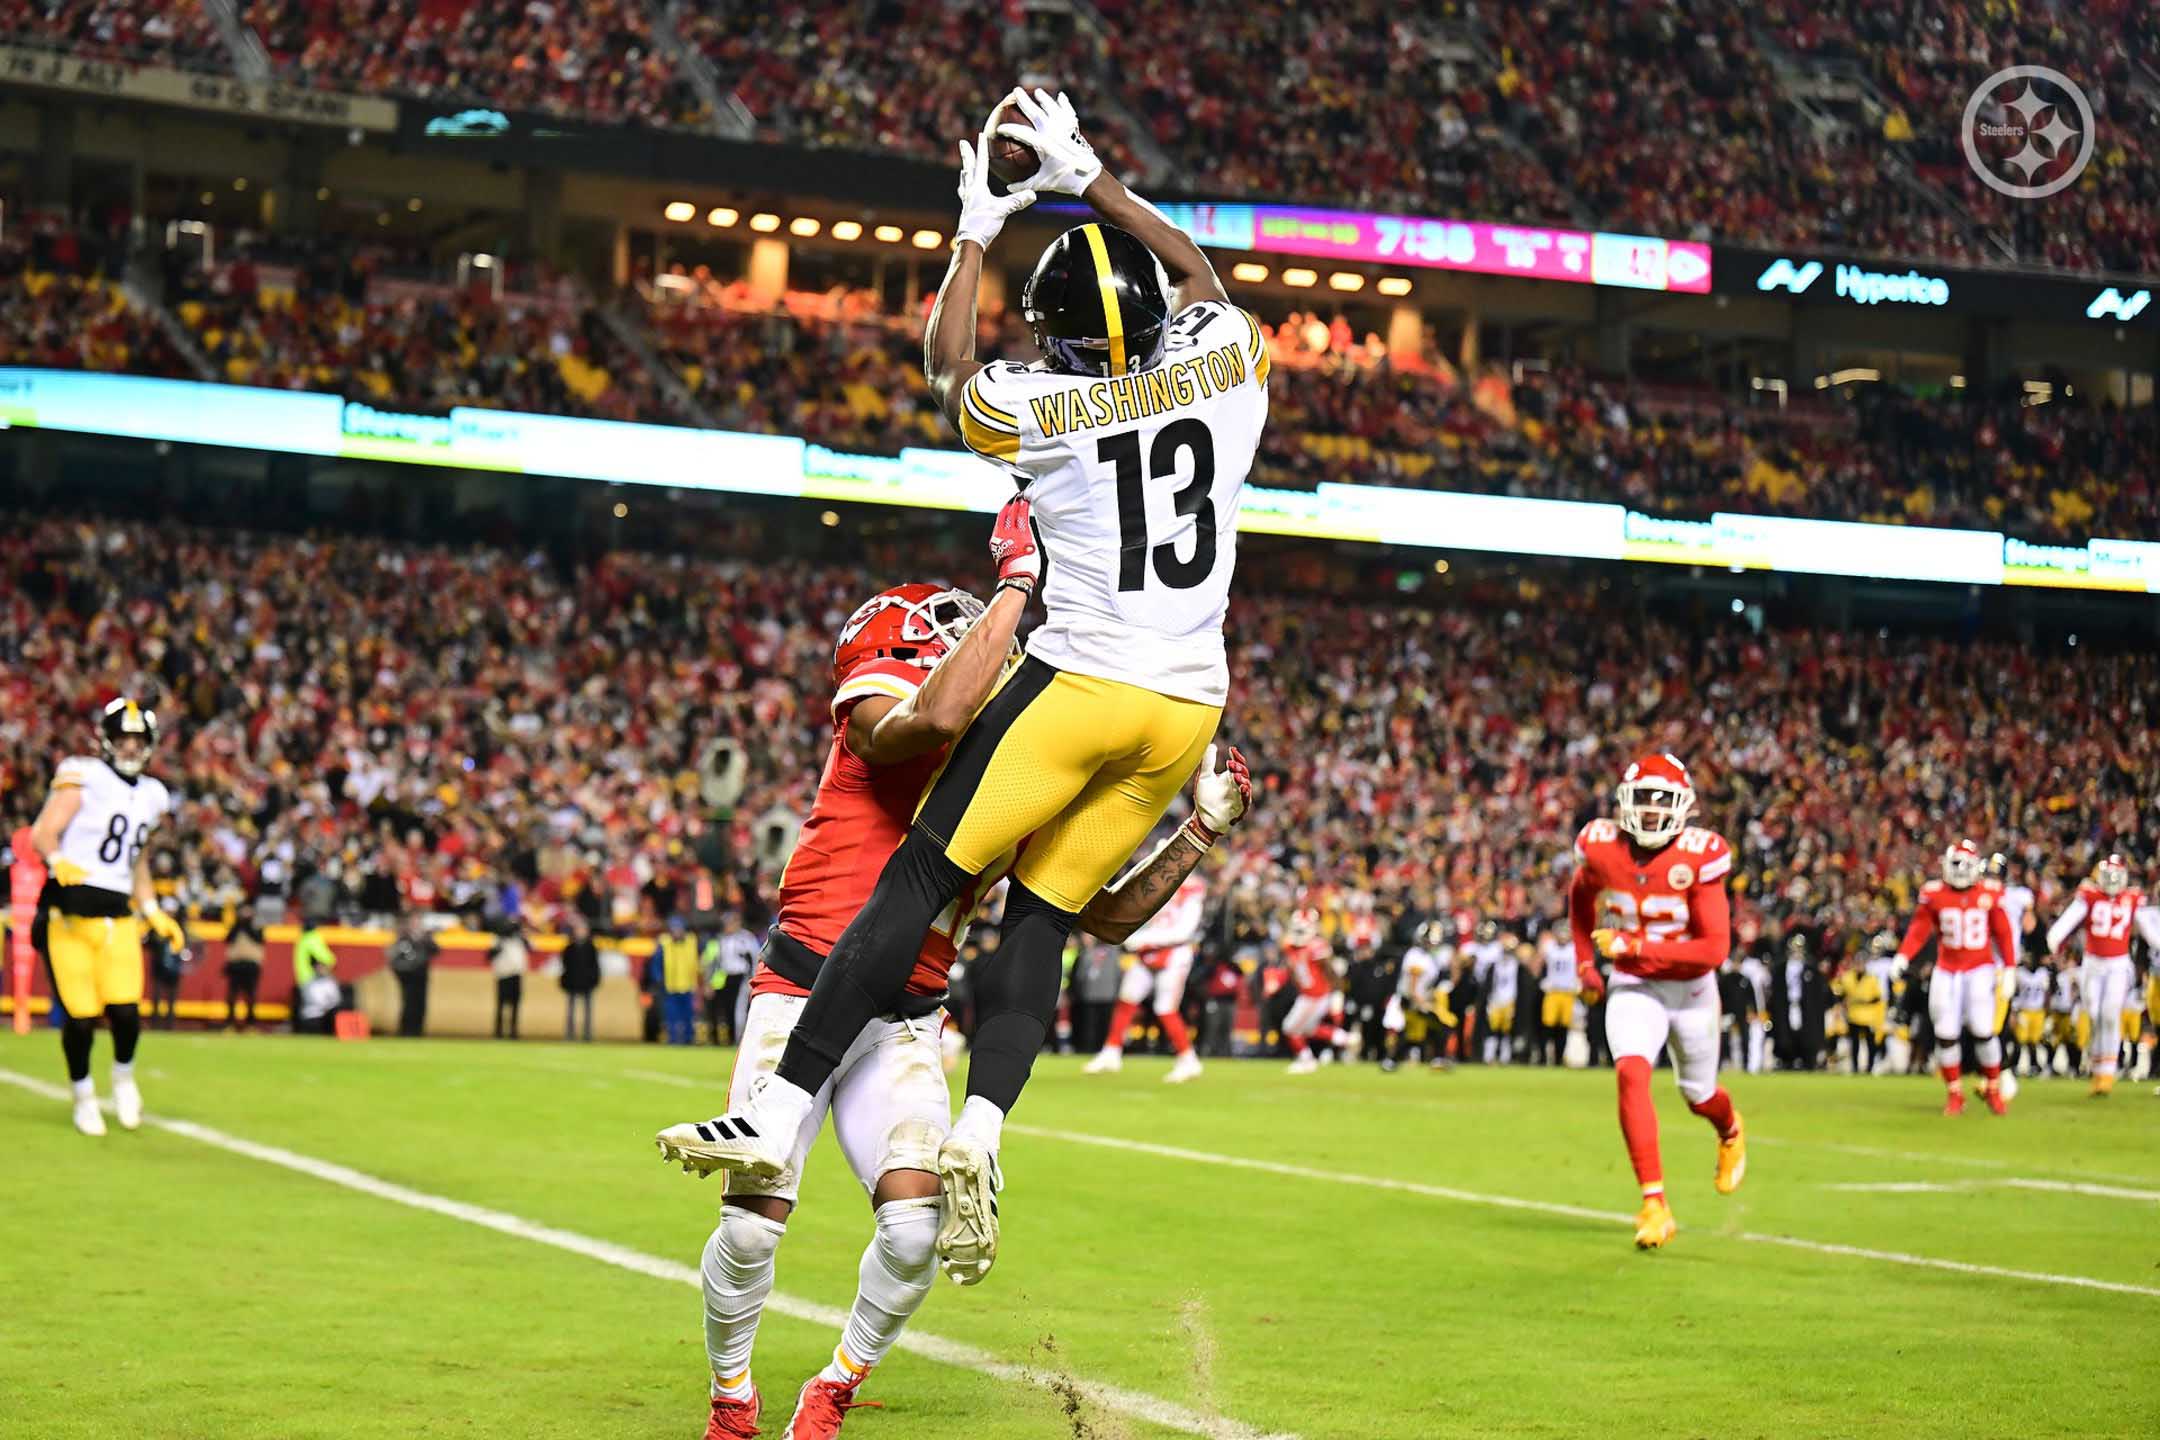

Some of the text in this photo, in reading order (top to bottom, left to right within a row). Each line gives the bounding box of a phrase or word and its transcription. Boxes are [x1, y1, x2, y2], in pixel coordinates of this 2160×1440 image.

[1030, 342, 1246, 438] WASHINGTON
[1097, 418, 1217, 592] 13
[1939, 907, 1988, 949] 98
[2091, 900, 2132, 940] 97
